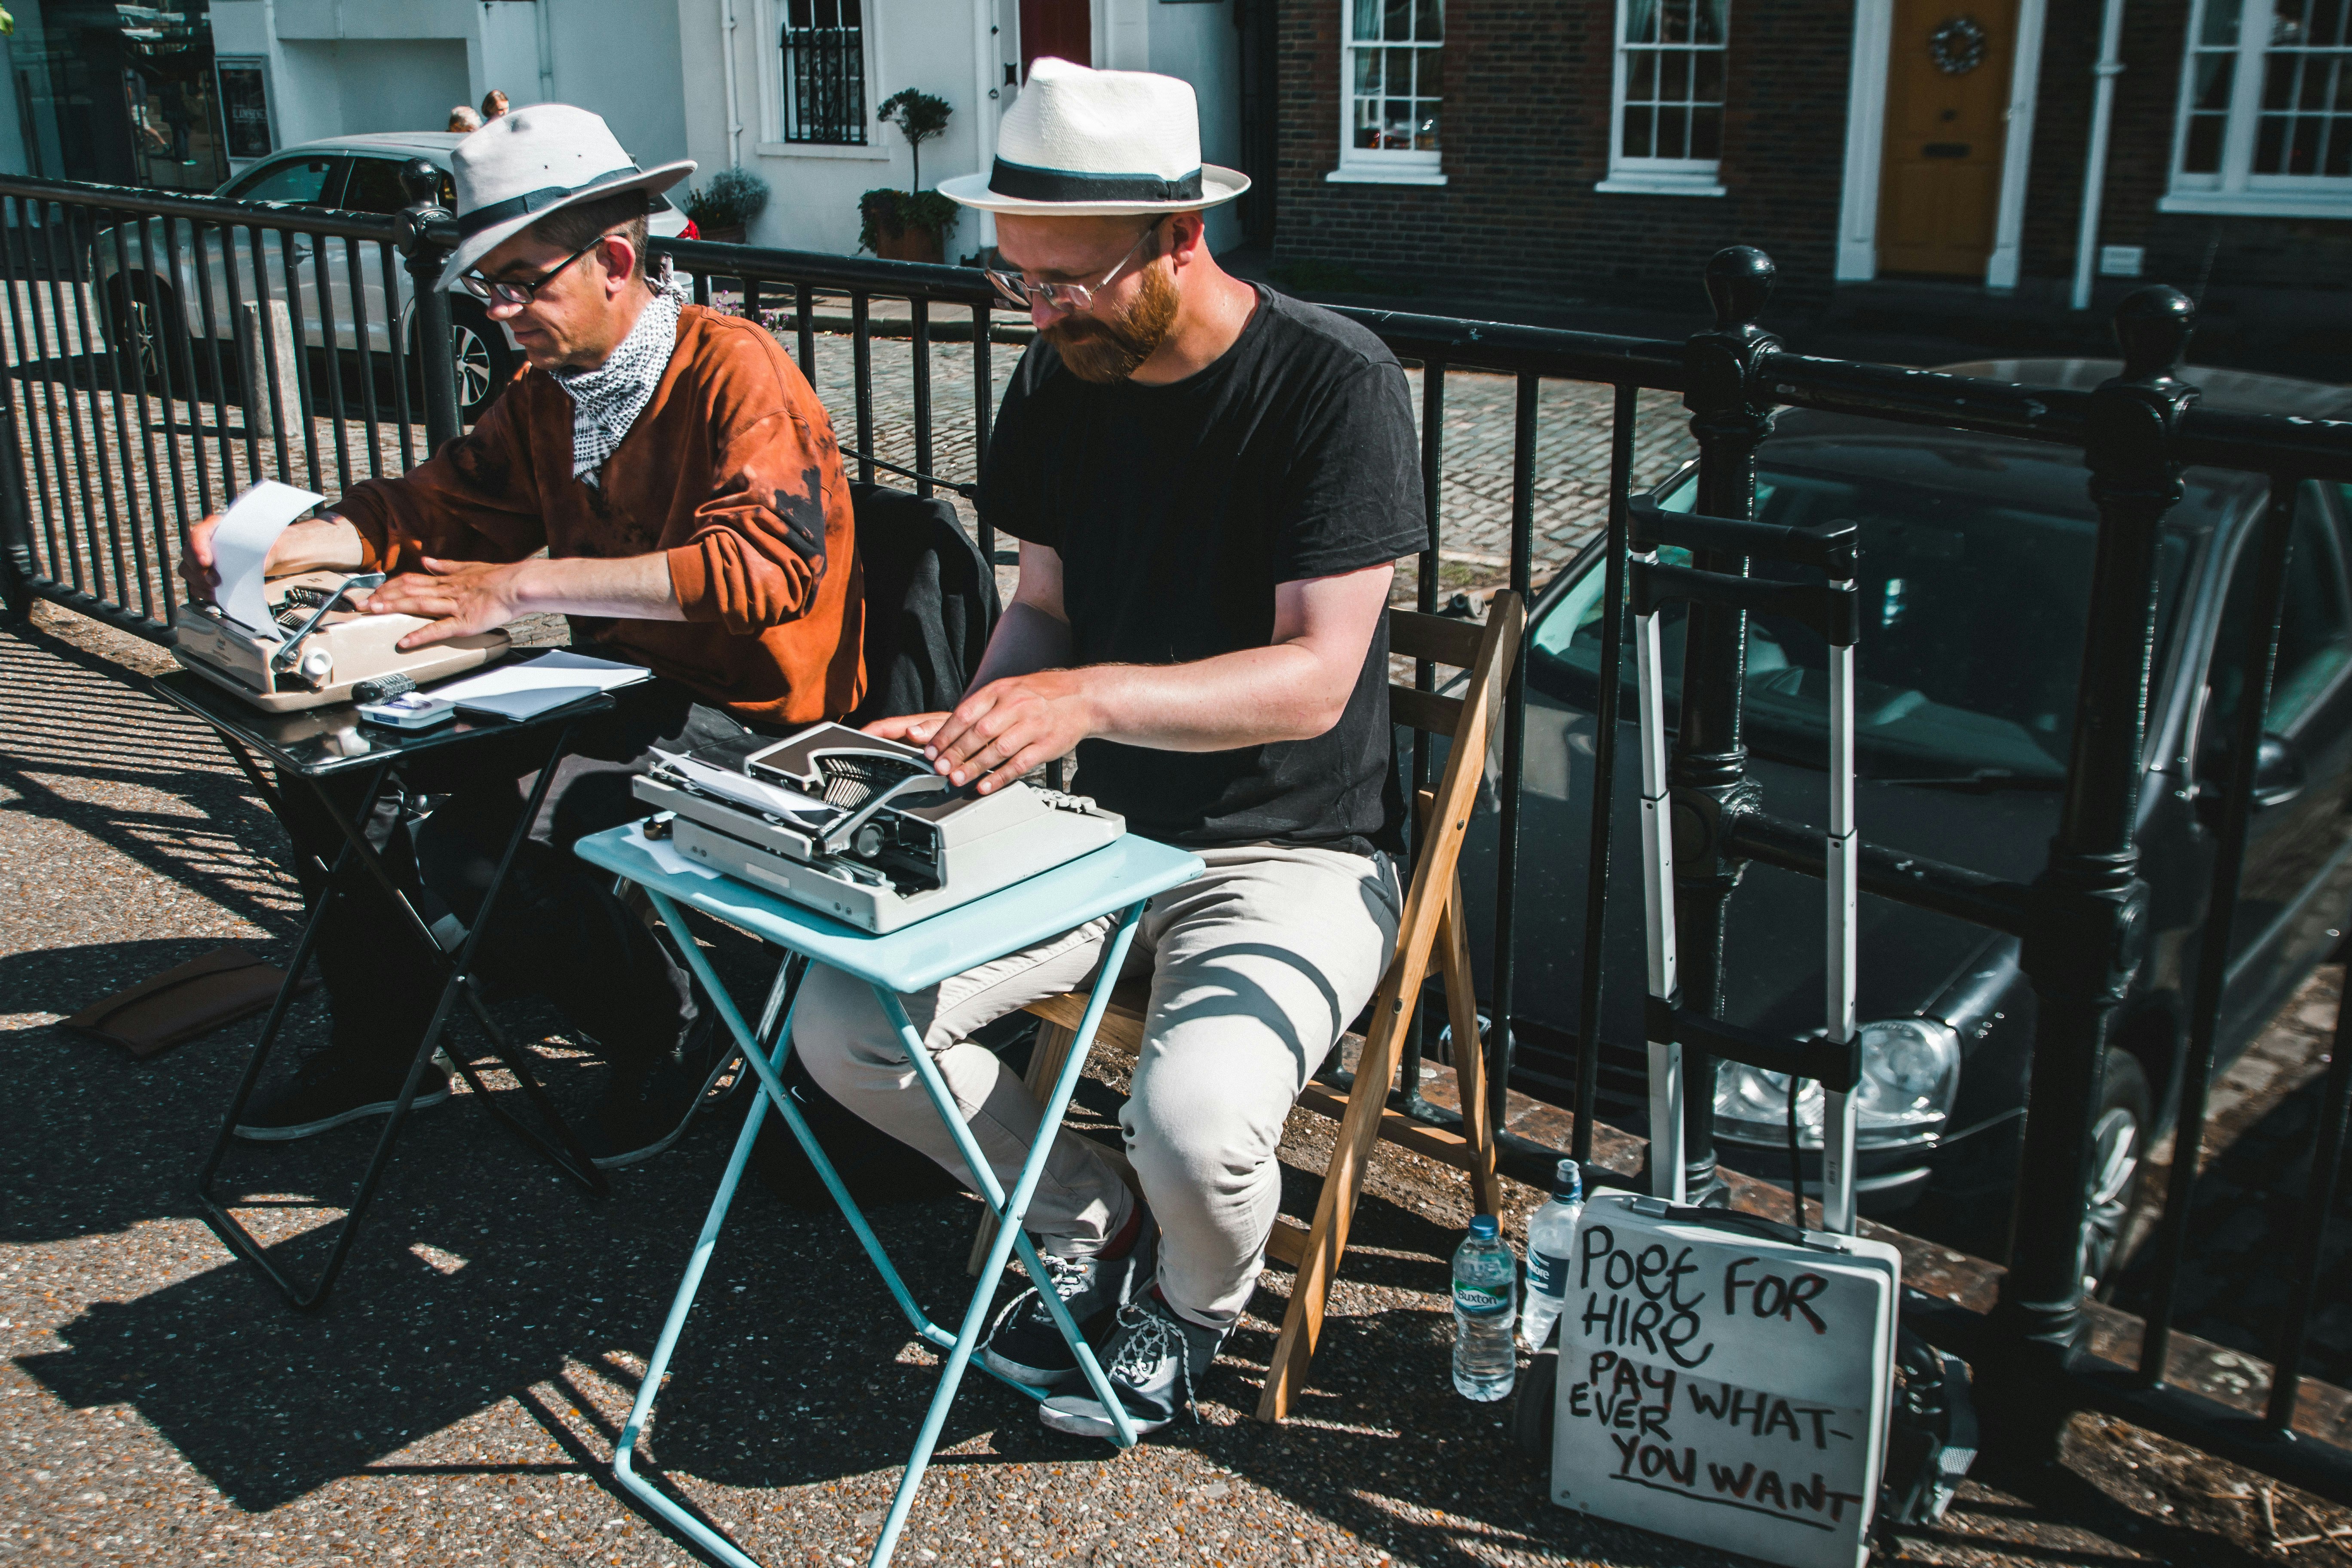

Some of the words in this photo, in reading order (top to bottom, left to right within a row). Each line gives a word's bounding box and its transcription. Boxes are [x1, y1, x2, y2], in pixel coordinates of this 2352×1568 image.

[1458, 1289, 1497, 1305] Buxton
[1724, 1256, 1829, 1335] FOR
[1569, 1381, 1673, 1442] EVER
[1590, 1350, 1676, 1412] PAY
[1611, 1433, 1697, 1487] YOU
[1707, 1462, 1864, 1523] WANT
